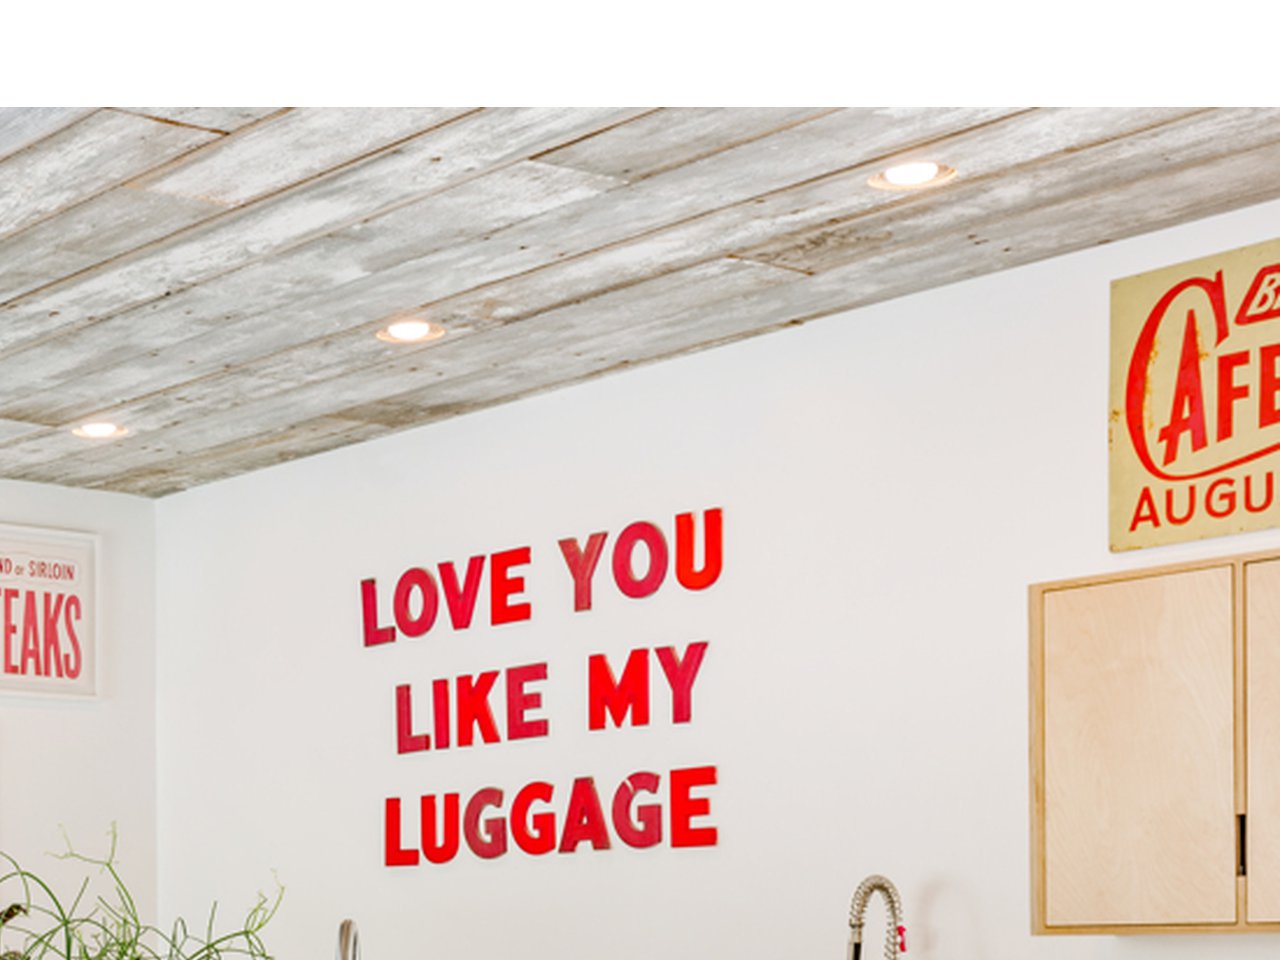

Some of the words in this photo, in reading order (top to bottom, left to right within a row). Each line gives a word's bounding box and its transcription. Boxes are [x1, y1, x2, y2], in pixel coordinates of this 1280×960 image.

[28, 560, 75, 580] SIRLOIN
[360, 546, 531, 648] LOVE
[558, 507, 723, 613] YOU
[395, 662, 549, 755] LIKE
[588, 641, 710, 731] MY
[384, 765, 719, 867] LUGGAGE
